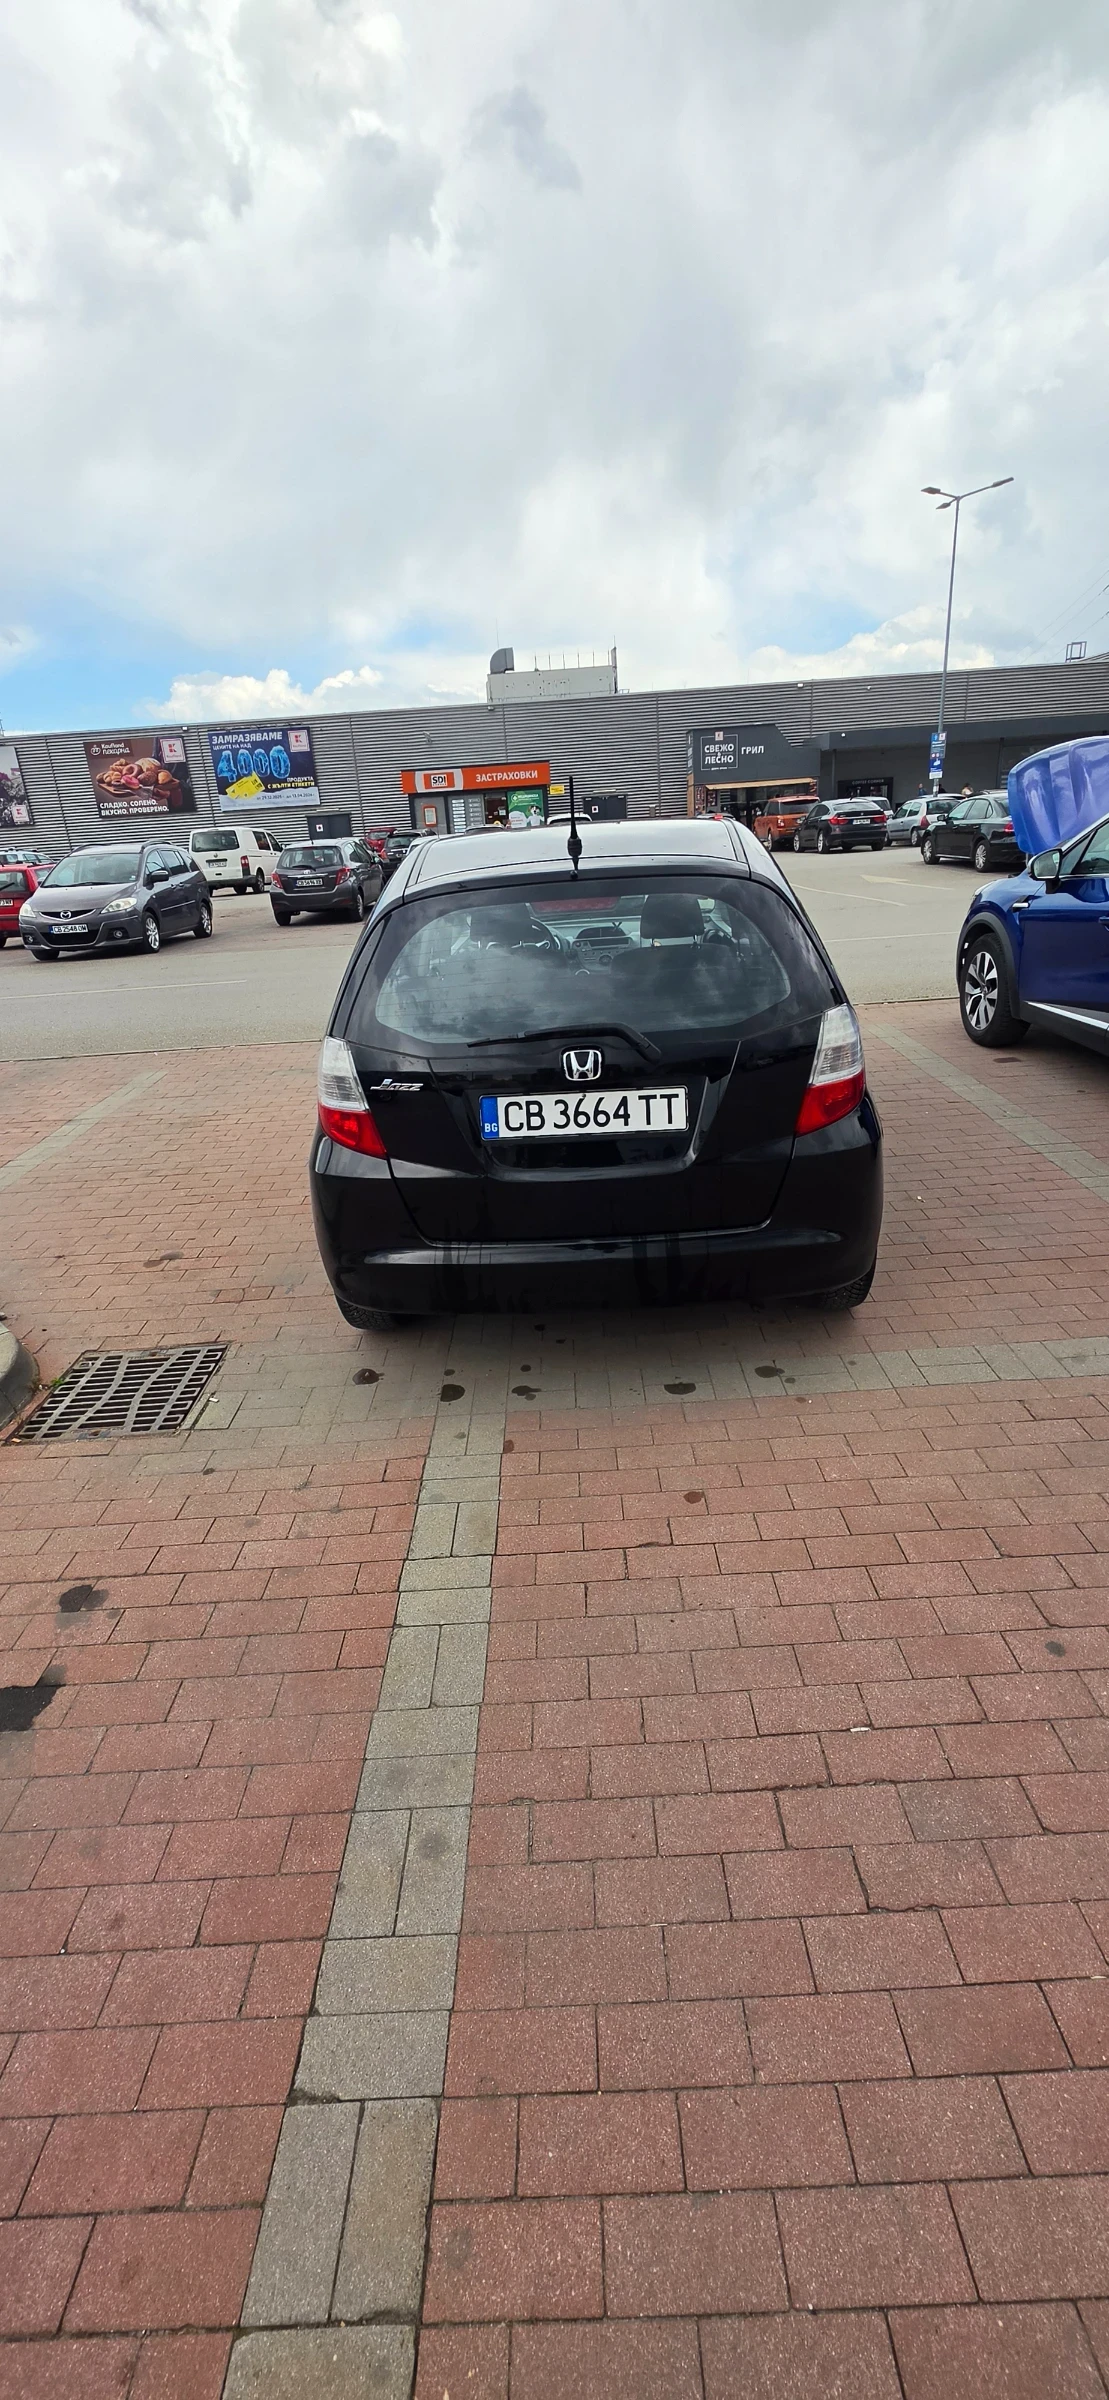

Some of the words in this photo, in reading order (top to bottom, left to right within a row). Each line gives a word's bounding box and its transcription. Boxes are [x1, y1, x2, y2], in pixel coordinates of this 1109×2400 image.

[212, 732, 283, 744] ЗАМРАЗЯВАМЕ
[704, 744, 734, 753] СВЕЖО
[741, 746, 764, 754] ГРИЛ
[217, 745, 290, 782] 4000
[705, 755, 734, 764] ЛЕСНО
[432, 775, 446, 784] SDI
[476, 770, 538, 782] ЗАСТРАХОВКИ
[100, 801, 129, 809] СЛАДКО.
[101, 808, 129, 816] ВКУСНО.
[129, 806, 169, 814] ПРОВЕРЕНО.
[370, 1078, 424, 1091] Jazz
[504, 1100, 545, 1131] CB
[554, 1096, 630, 1129] 3664
[638, 1094, 680, 1126] TT
[484, 1123, 498, 1133] BG
